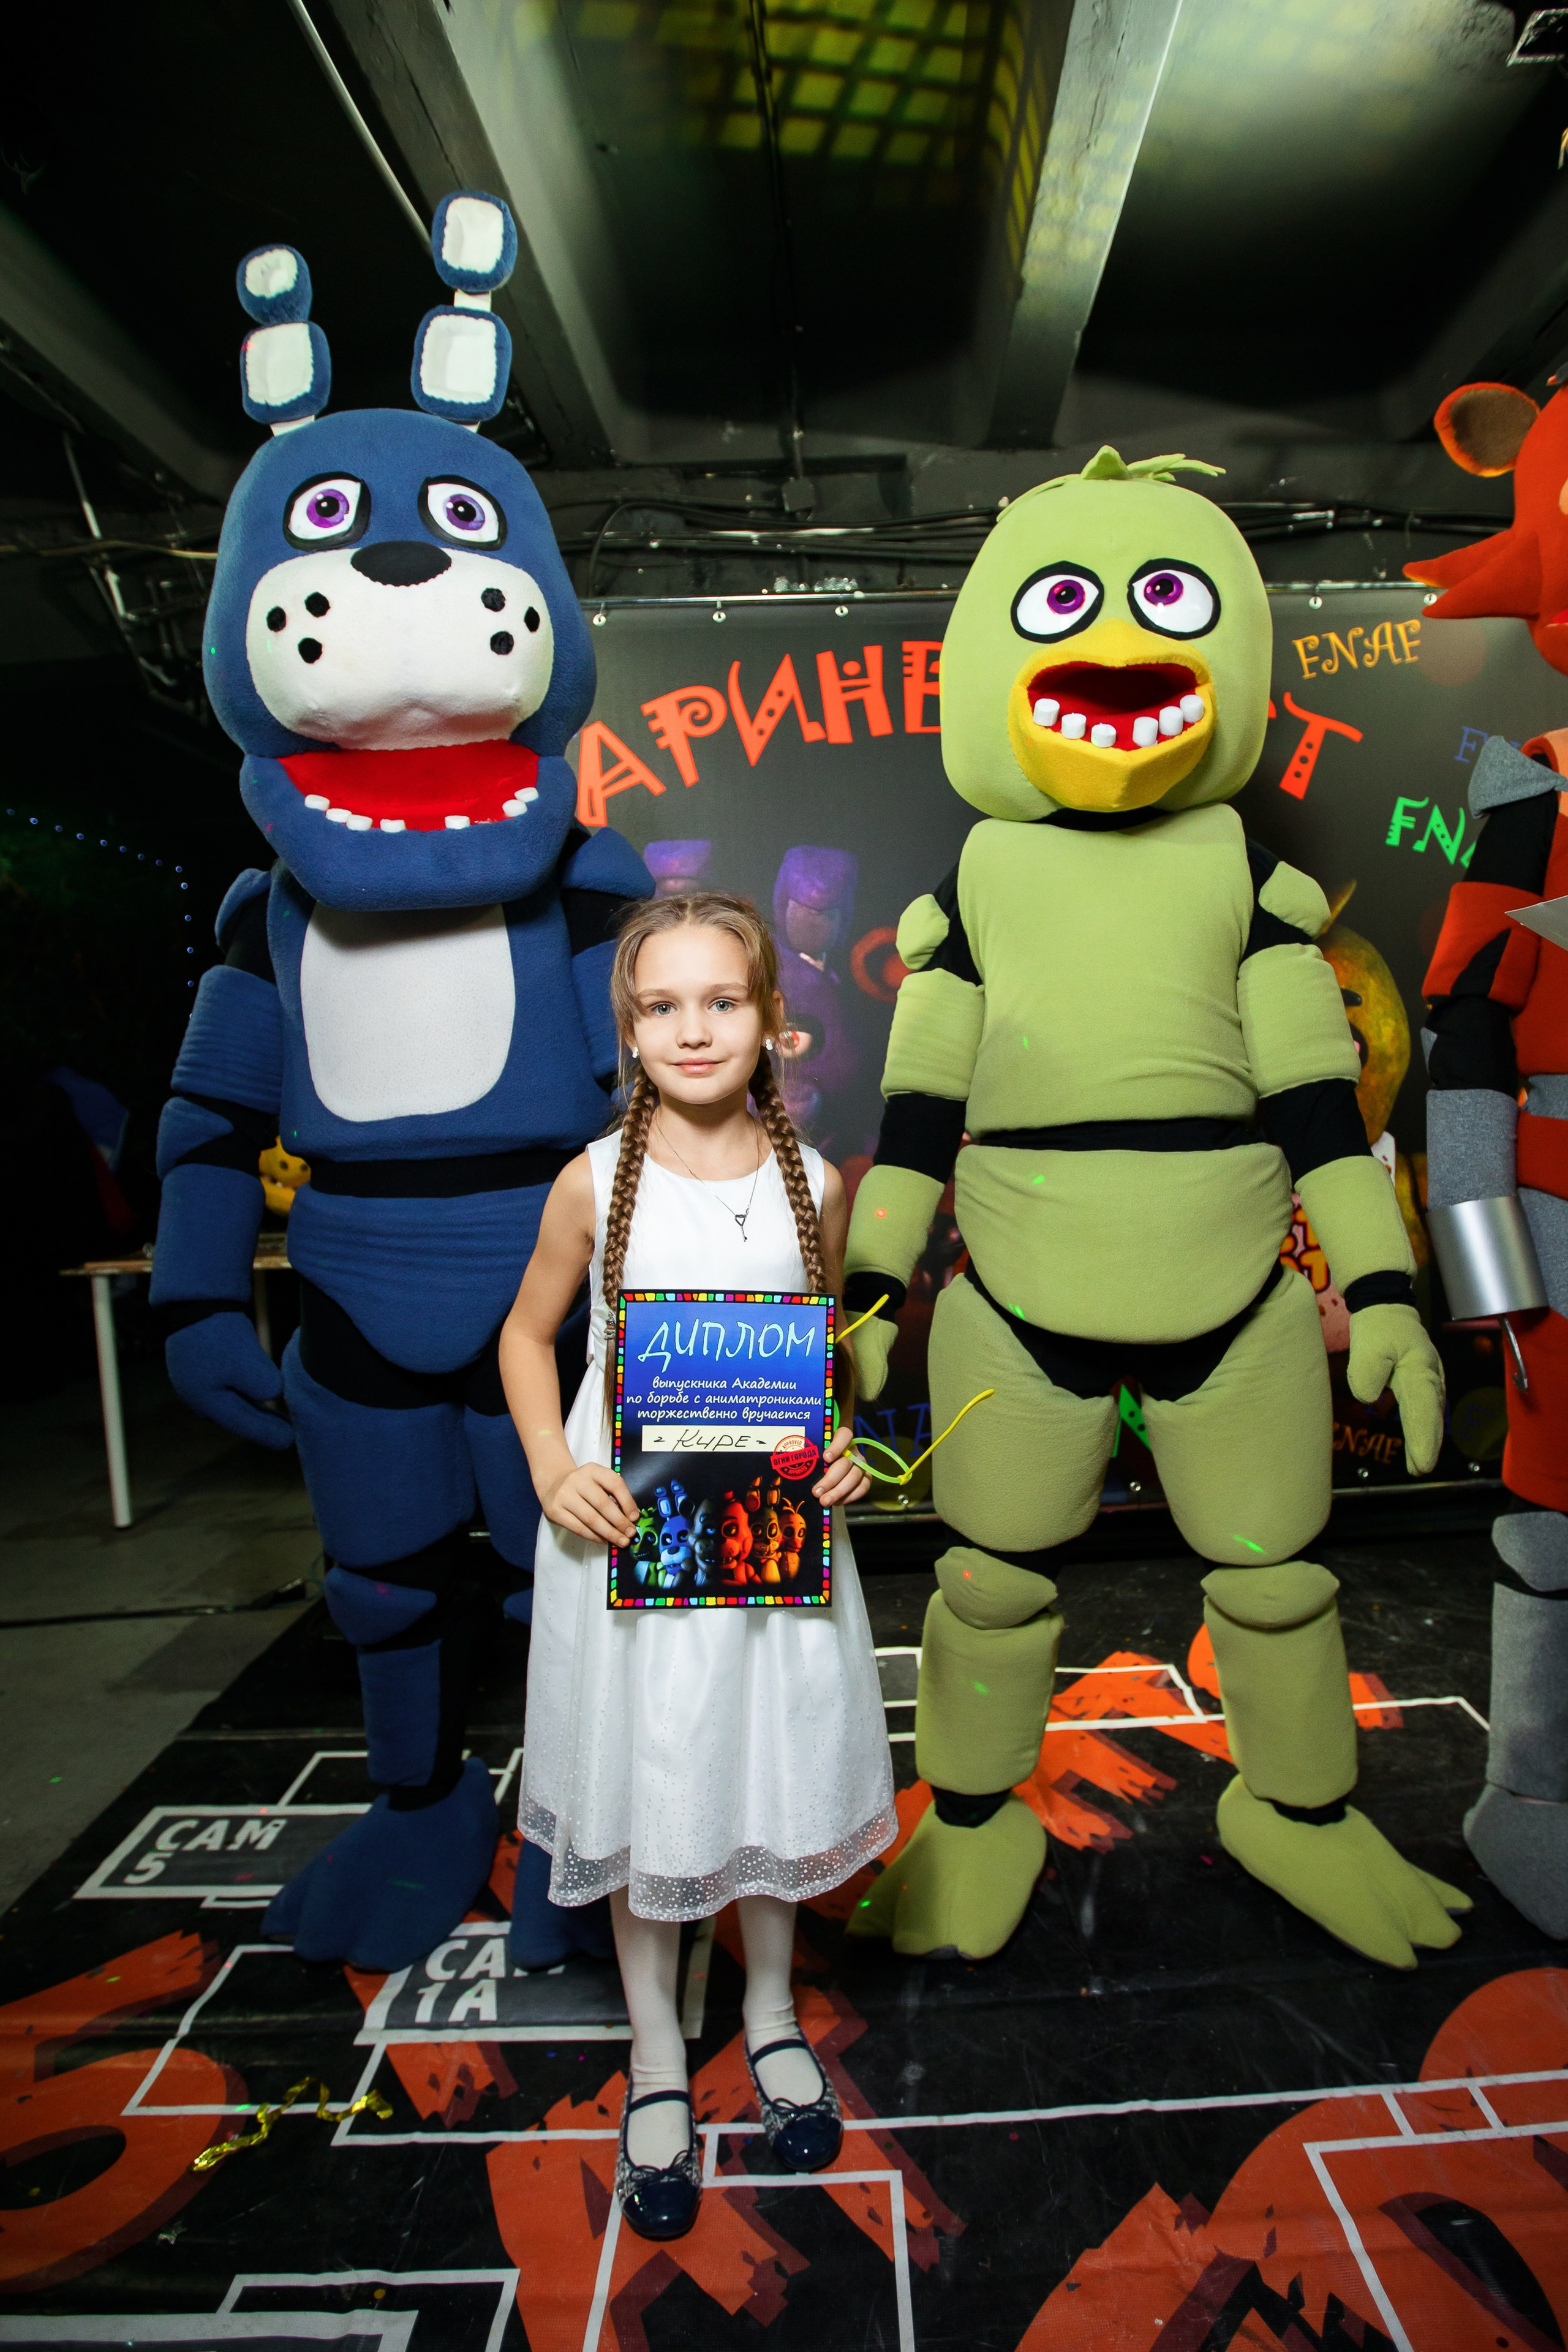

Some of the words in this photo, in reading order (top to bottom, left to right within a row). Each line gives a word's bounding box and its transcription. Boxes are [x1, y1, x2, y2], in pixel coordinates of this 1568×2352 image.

[1292, 619, 1422, 680] FNAF
[1385, 796, 1477, 869] FN
[637, 1318, 815, 1373] ДИПЛОМ
[626, 1395, 643, 1404] по
[647, 1391, 689, 1407] борьбе
[693, 1395, 701, 1403] с
[705, 1395, 821, 1408] аниматрониками
[652, 1376, 727, 1393] выпускника
[731, 1377, 797, 1390] Академии
[637, 1407, 737, 1422] торжественно
[742, 1406, 810, 1422] вручается
[773, 1455, 790, 1466] ОГНИ
[791, 1449, 817, 1462] ГОРОДА
[154, 1817, 289, 1852] CAM
[123, 1852, 176, 1885] 5
[414, 1980, 499, 2024] 1A
